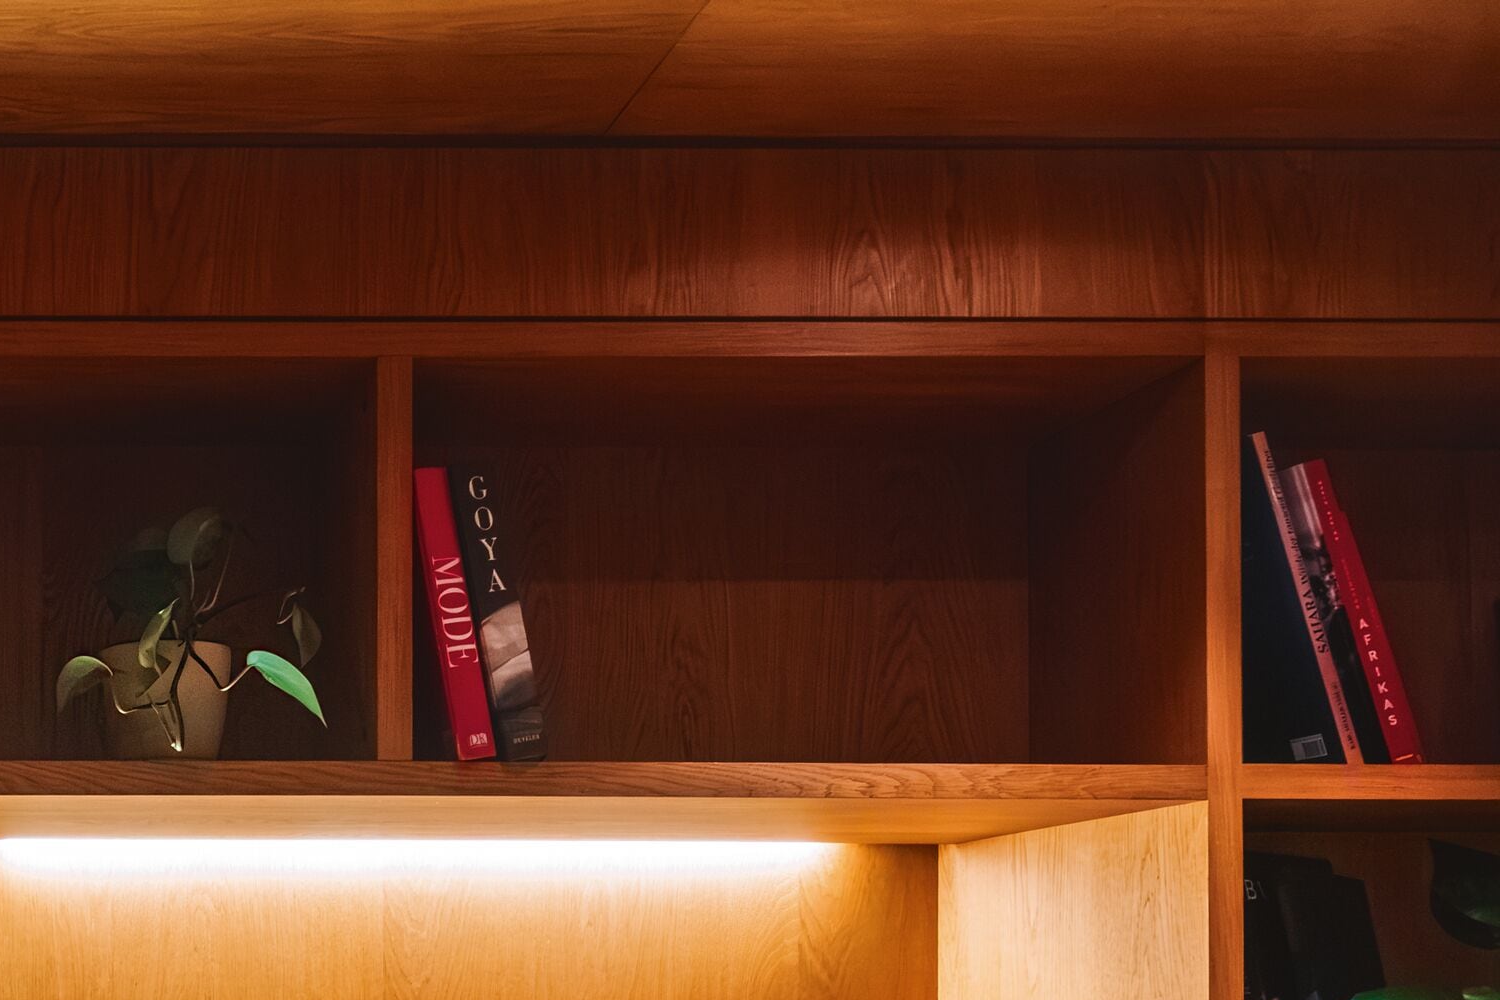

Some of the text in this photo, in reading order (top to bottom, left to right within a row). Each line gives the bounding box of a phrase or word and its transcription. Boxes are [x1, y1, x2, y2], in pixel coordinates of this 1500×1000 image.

[468, 475, 507, 593] GOYA
[431, 556, 479, 669] MODE
[1302, 589, 1329, 654] SAHARA
[1359, 617, 1398, 726] AFRIKAS
